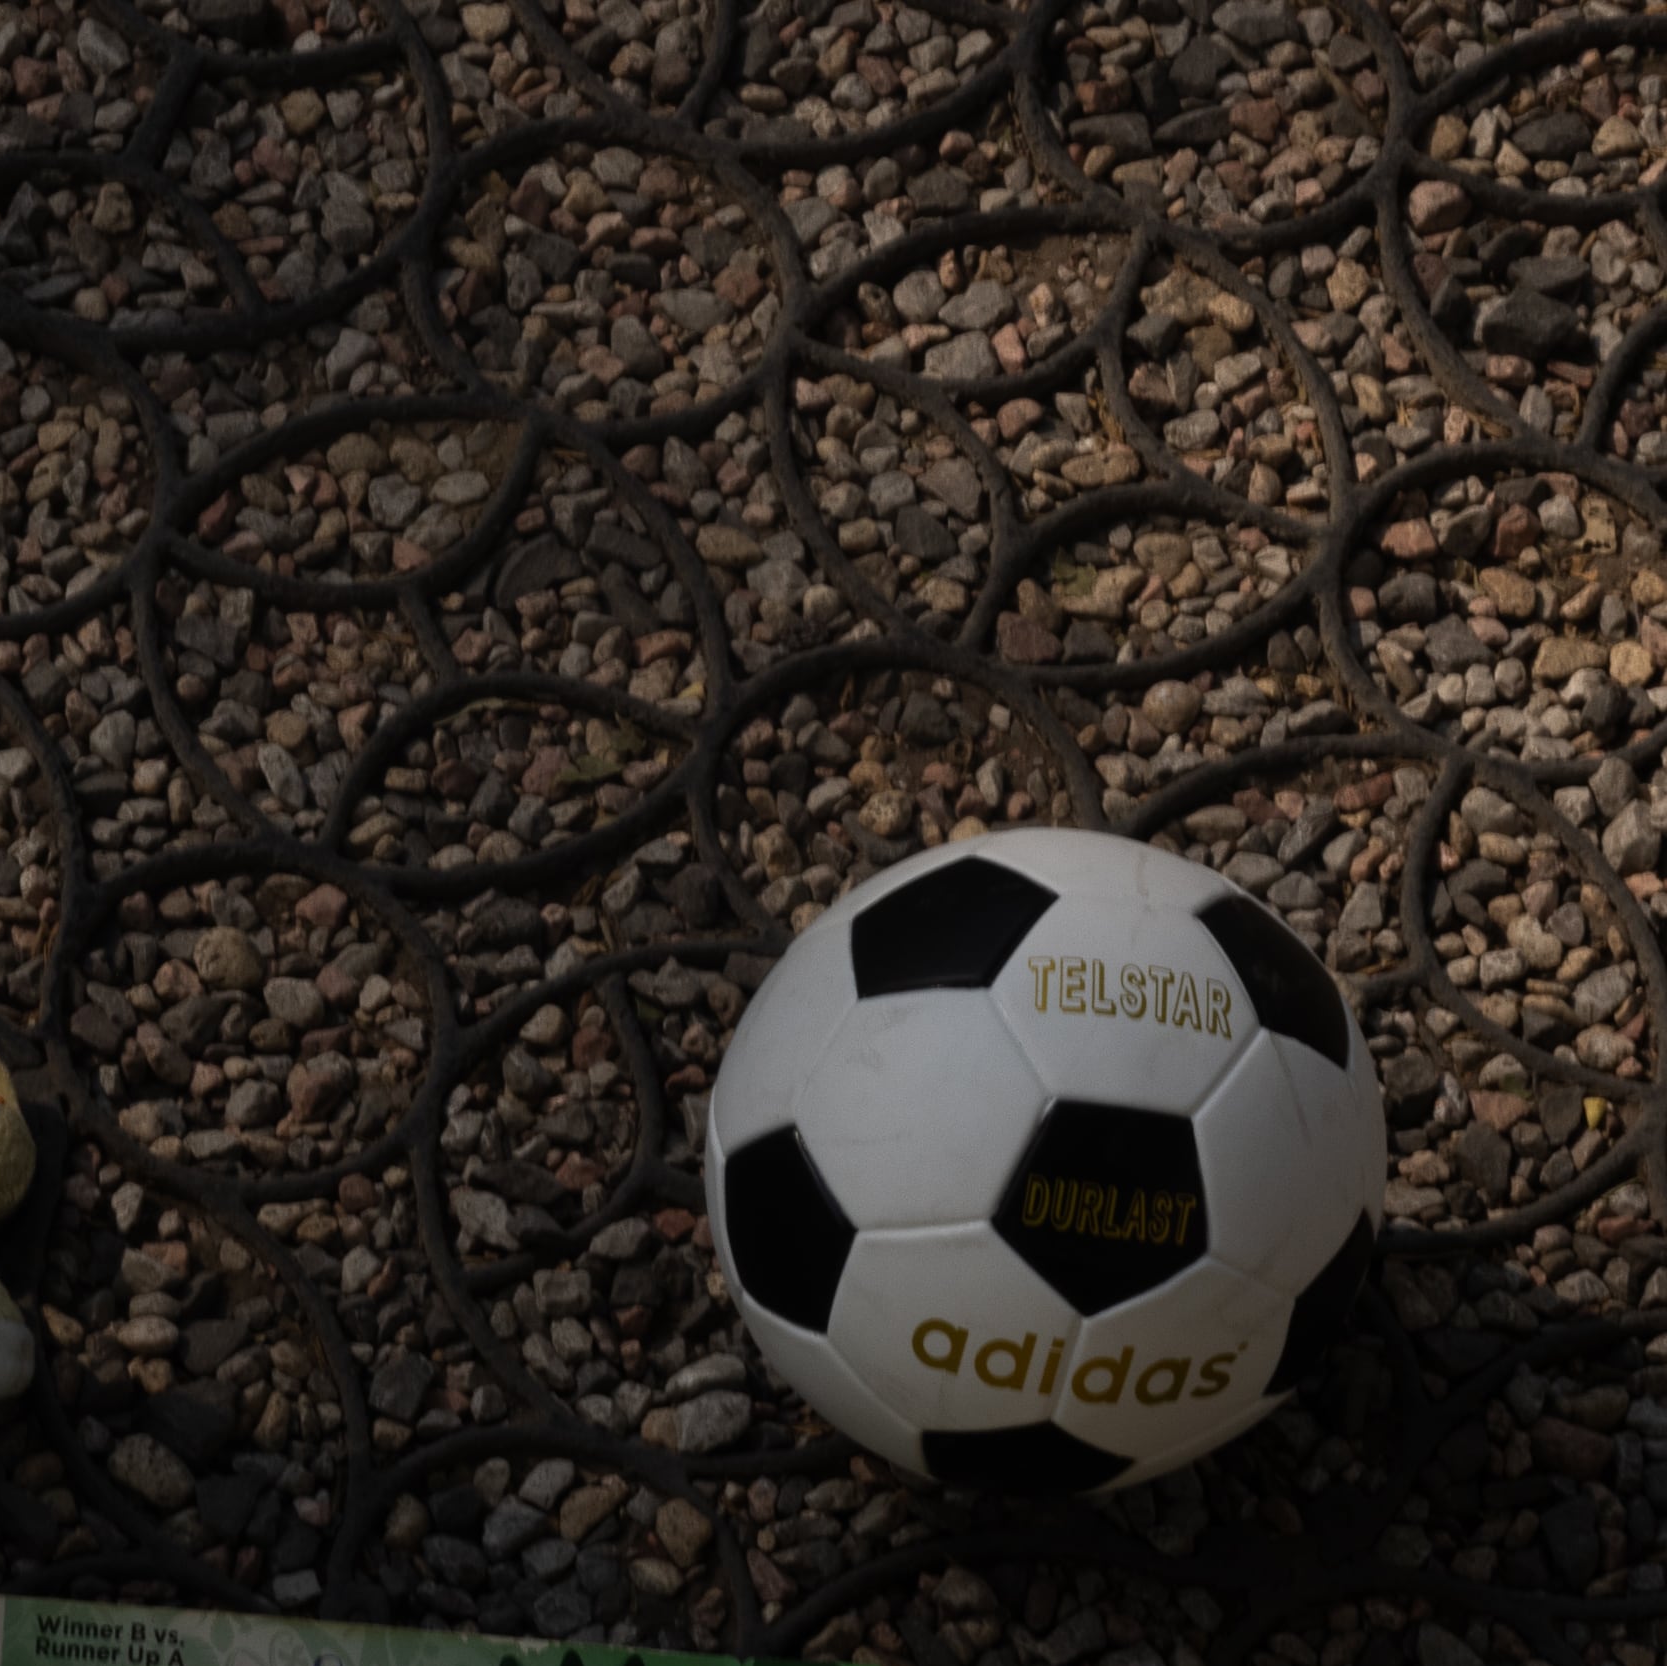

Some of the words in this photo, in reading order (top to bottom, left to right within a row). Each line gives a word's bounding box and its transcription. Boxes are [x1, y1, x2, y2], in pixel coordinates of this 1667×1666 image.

[1027, 956, 1232, 1040] TELSTAR
[1023, 1175, 1197, 1245] DURLAST
[911, 1316, 1235, 1407] adidas
[35, 1638, 119, 1663] Runner
[37, 1614, 123, 1640] Winner
[131, 1621, 146, 1640] B
[154, 1628, 185, 1647] vs.
